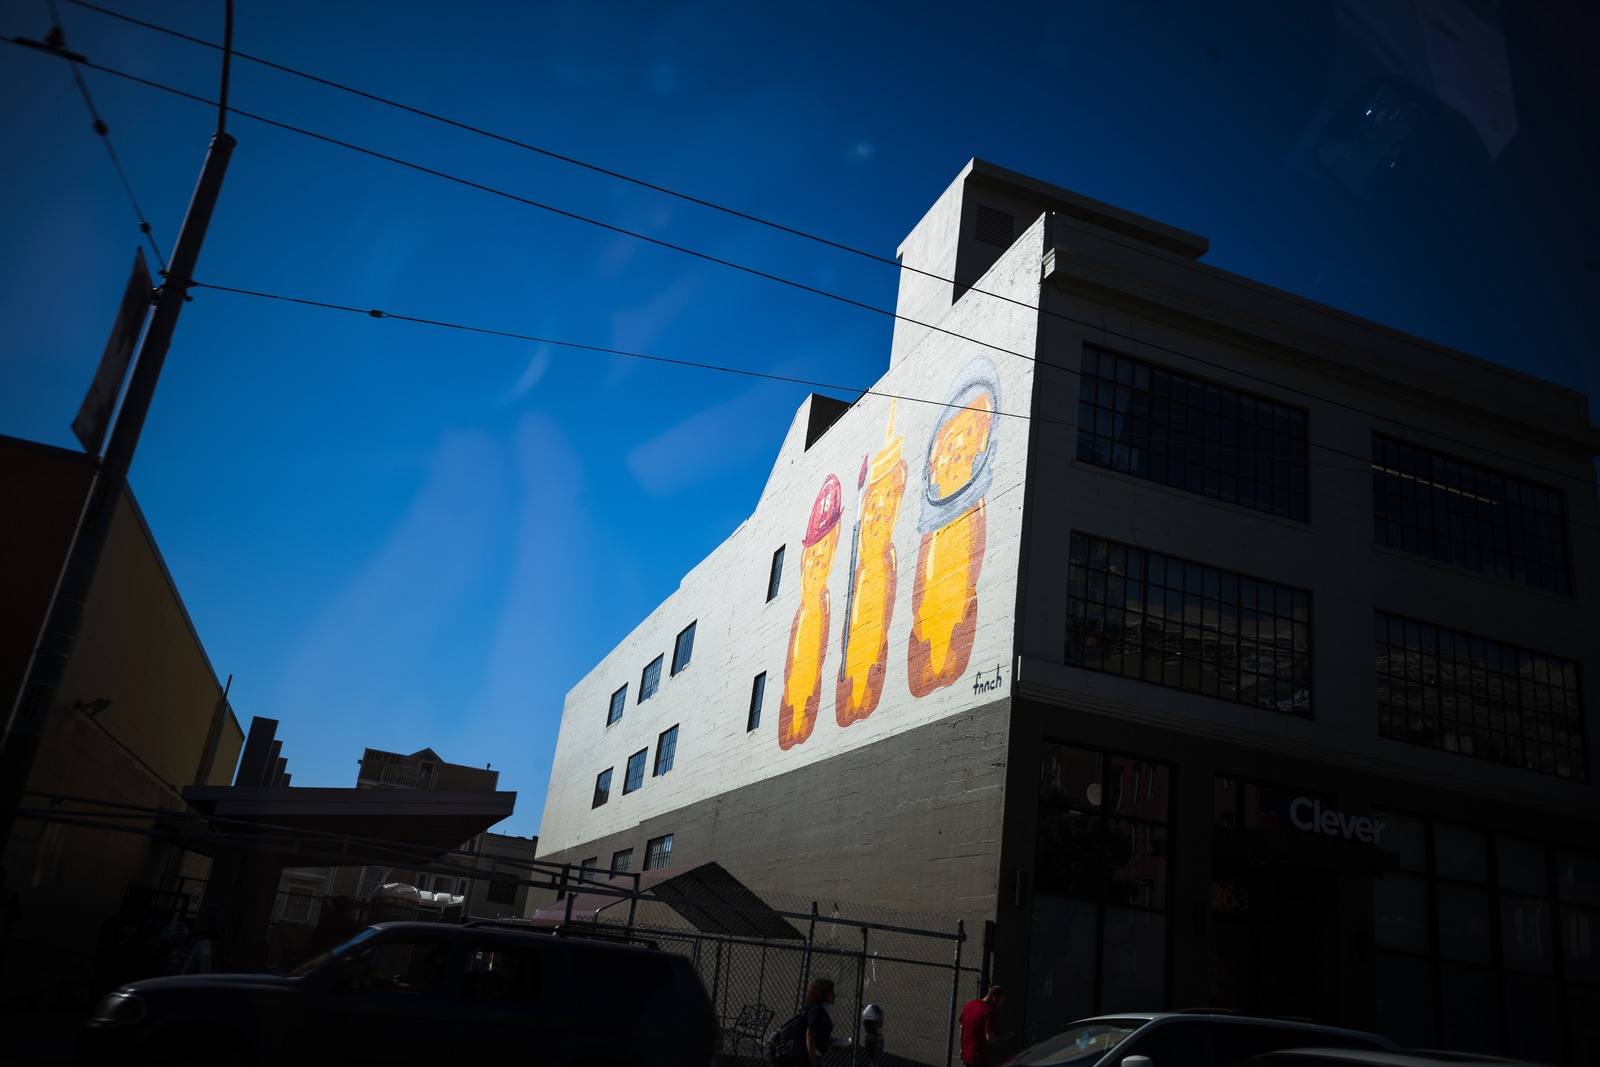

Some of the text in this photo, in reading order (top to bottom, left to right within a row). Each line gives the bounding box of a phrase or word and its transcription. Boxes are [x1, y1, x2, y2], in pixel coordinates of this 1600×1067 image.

[820, 493, 832, 515] 18
[973, 663, 1002, 695] fnnch
[367, 750, 401, 765] HOTEL
[1289, 796, 1386, 845] Clever
[1211, 882, 1249, 911] 263
